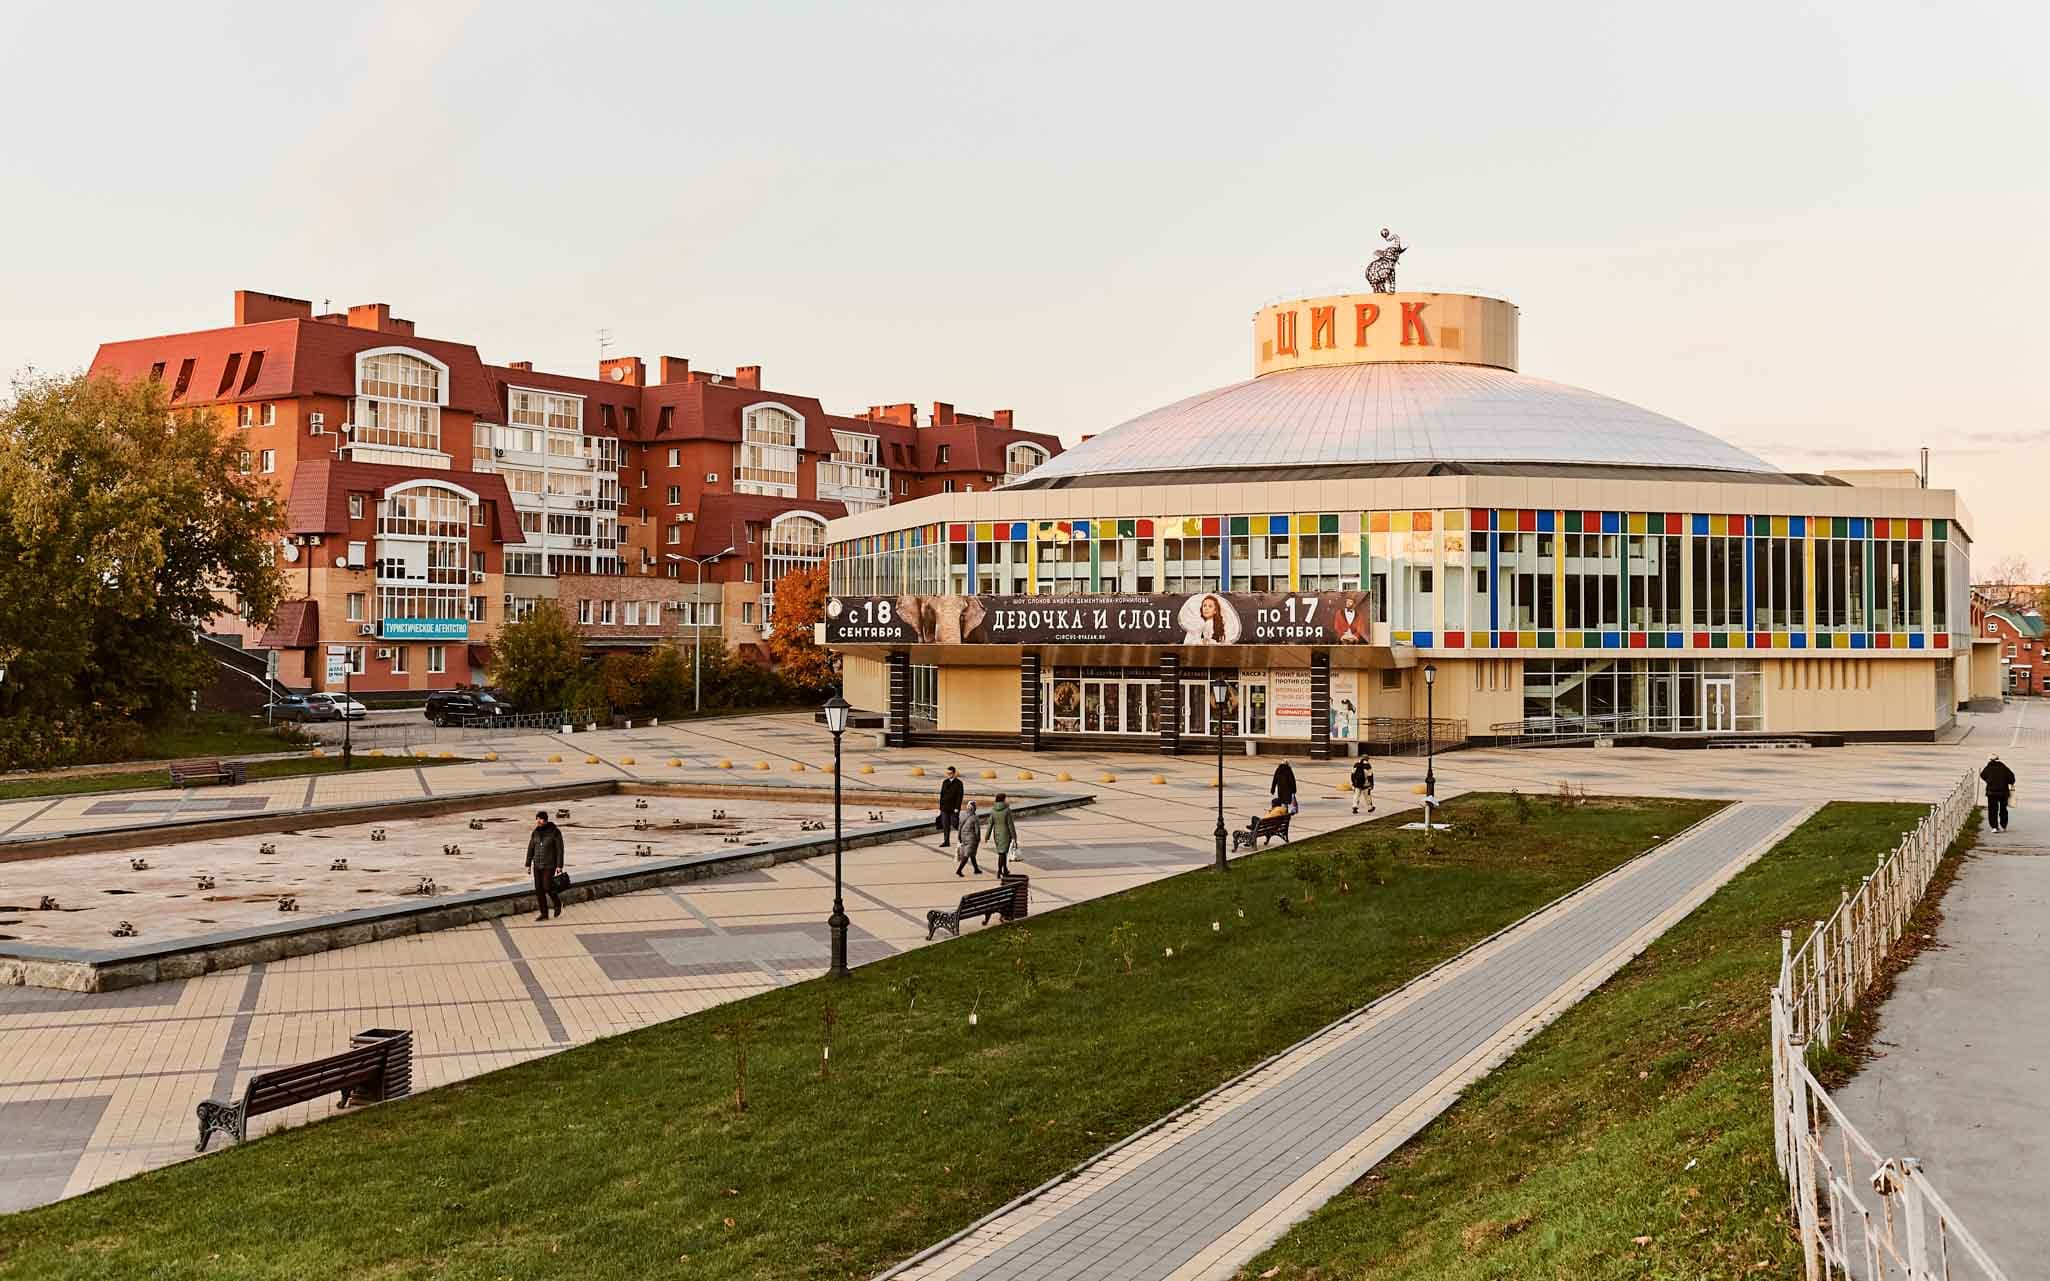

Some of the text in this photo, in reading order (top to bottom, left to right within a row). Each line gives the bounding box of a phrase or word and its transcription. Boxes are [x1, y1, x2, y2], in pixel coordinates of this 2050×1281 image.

[1275, 302, 1430, 358] ЦИРК
[864, 601, 892, 624] 18
[993, 609, 1172, 631] ДЕВОЧКА И СЛОН
[1285, 597, 1319, 624] 17
[386, 623, 467, 633] ТУРИСТИЧЕСКОЕ АГЕНТСТВО
[839, 627, 902, 638] СЕНТЯБРЯ
[1256, 626, 1324, 638] ОКТЯБРЯ
